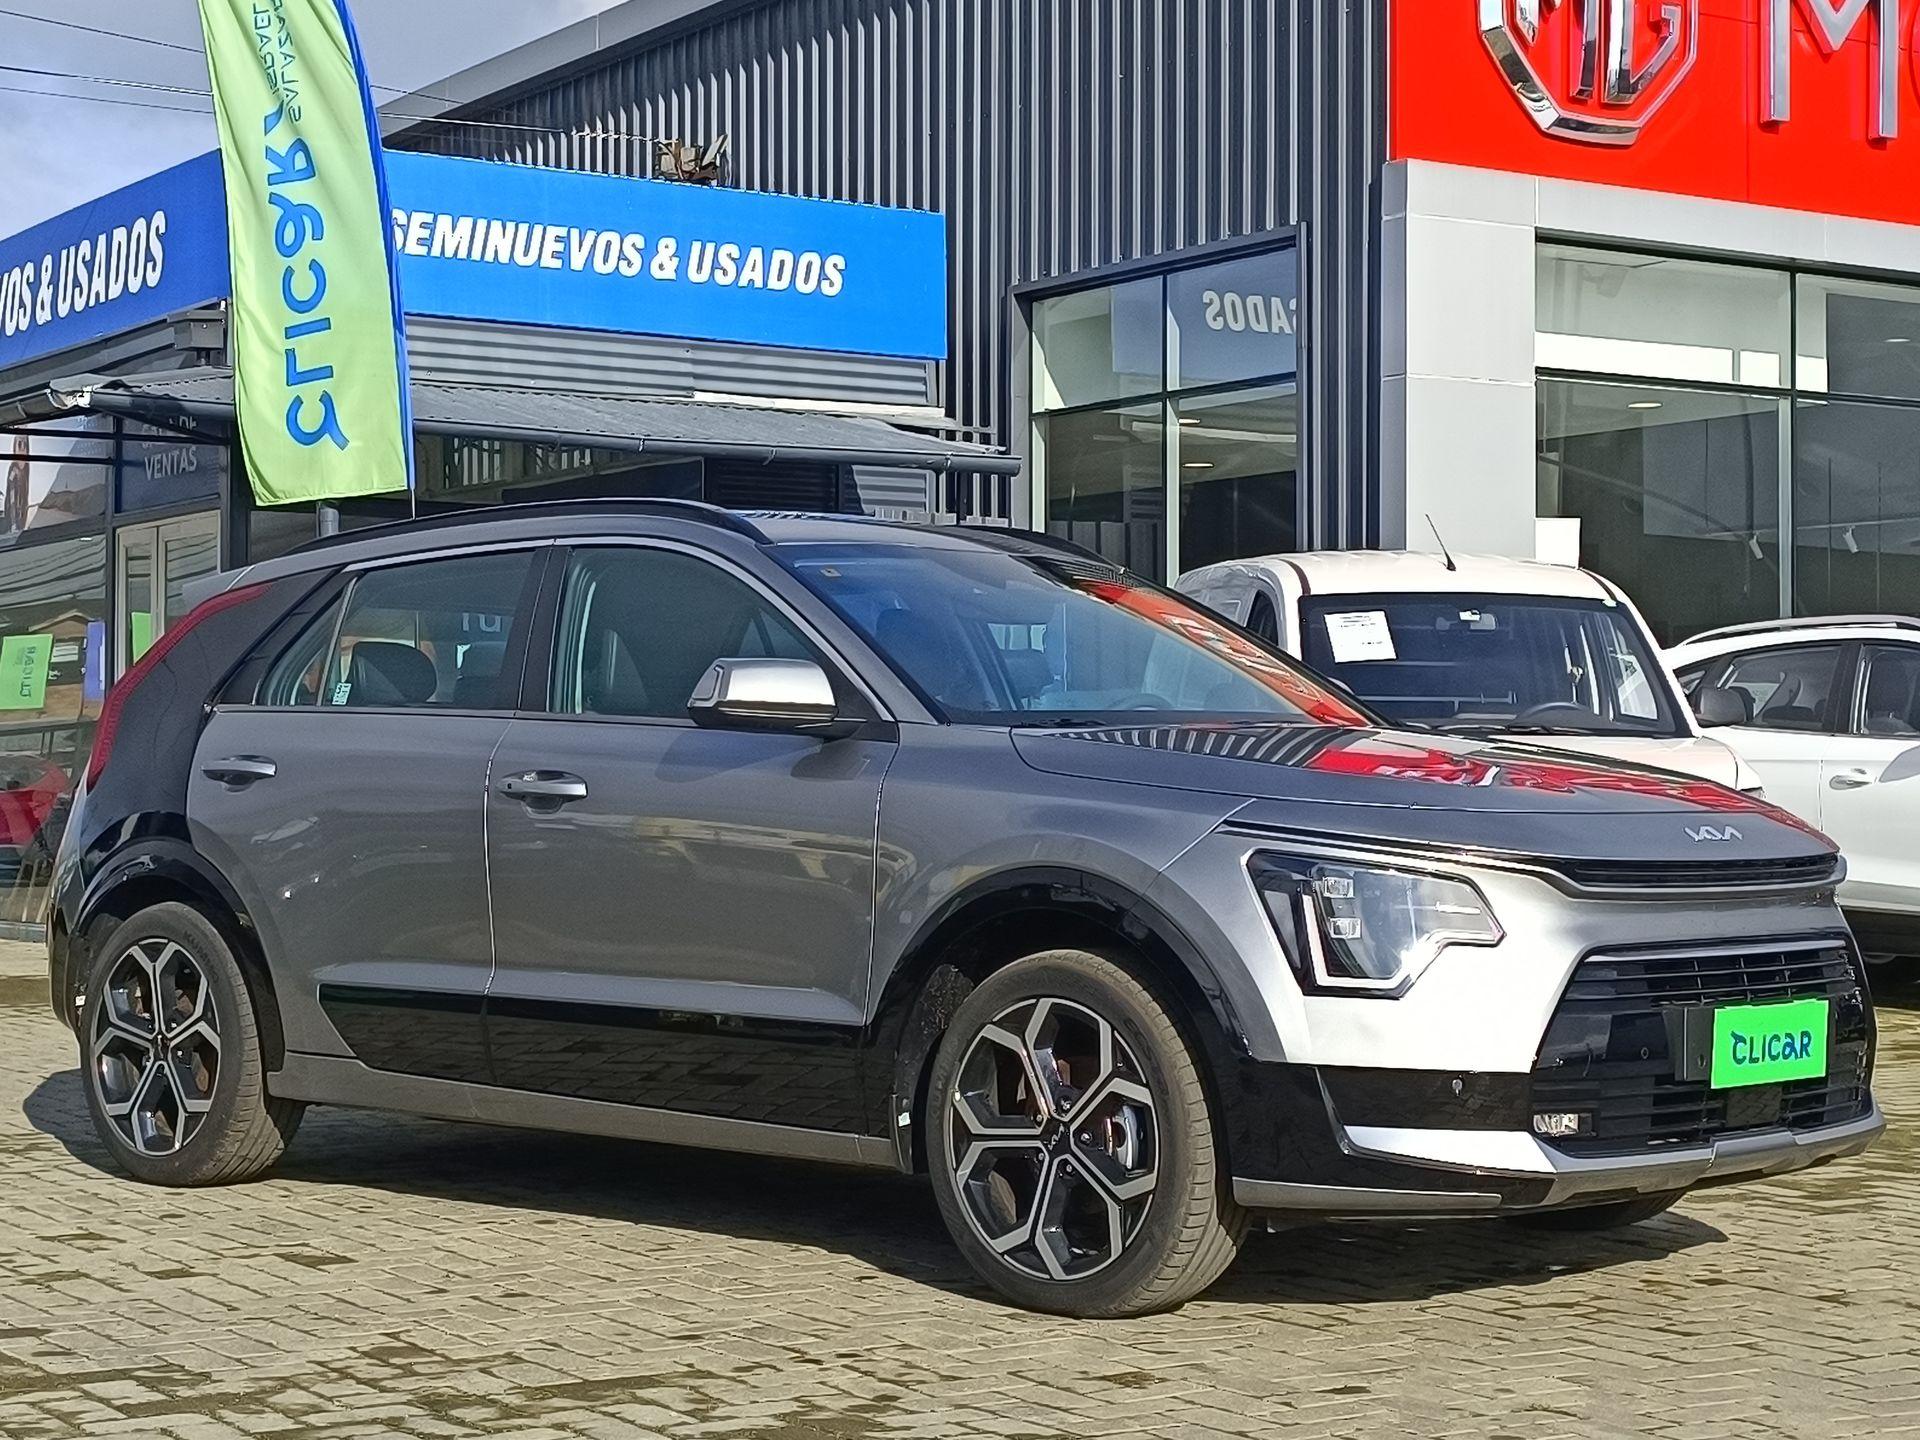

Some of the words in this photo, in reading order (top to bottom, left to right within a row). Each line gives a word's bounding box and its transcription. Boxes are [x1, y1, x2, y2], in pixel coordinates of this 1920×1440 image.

[35, 254, 53, 326] &
[57, 210, 166, 319] USADOS
[391, 206, 644, 279] SEMINUEVOS
[648, 236, 678, 282] &
[687, 241, 847, 298] USADOS
[143, 446, 198, 481] VENTAS
